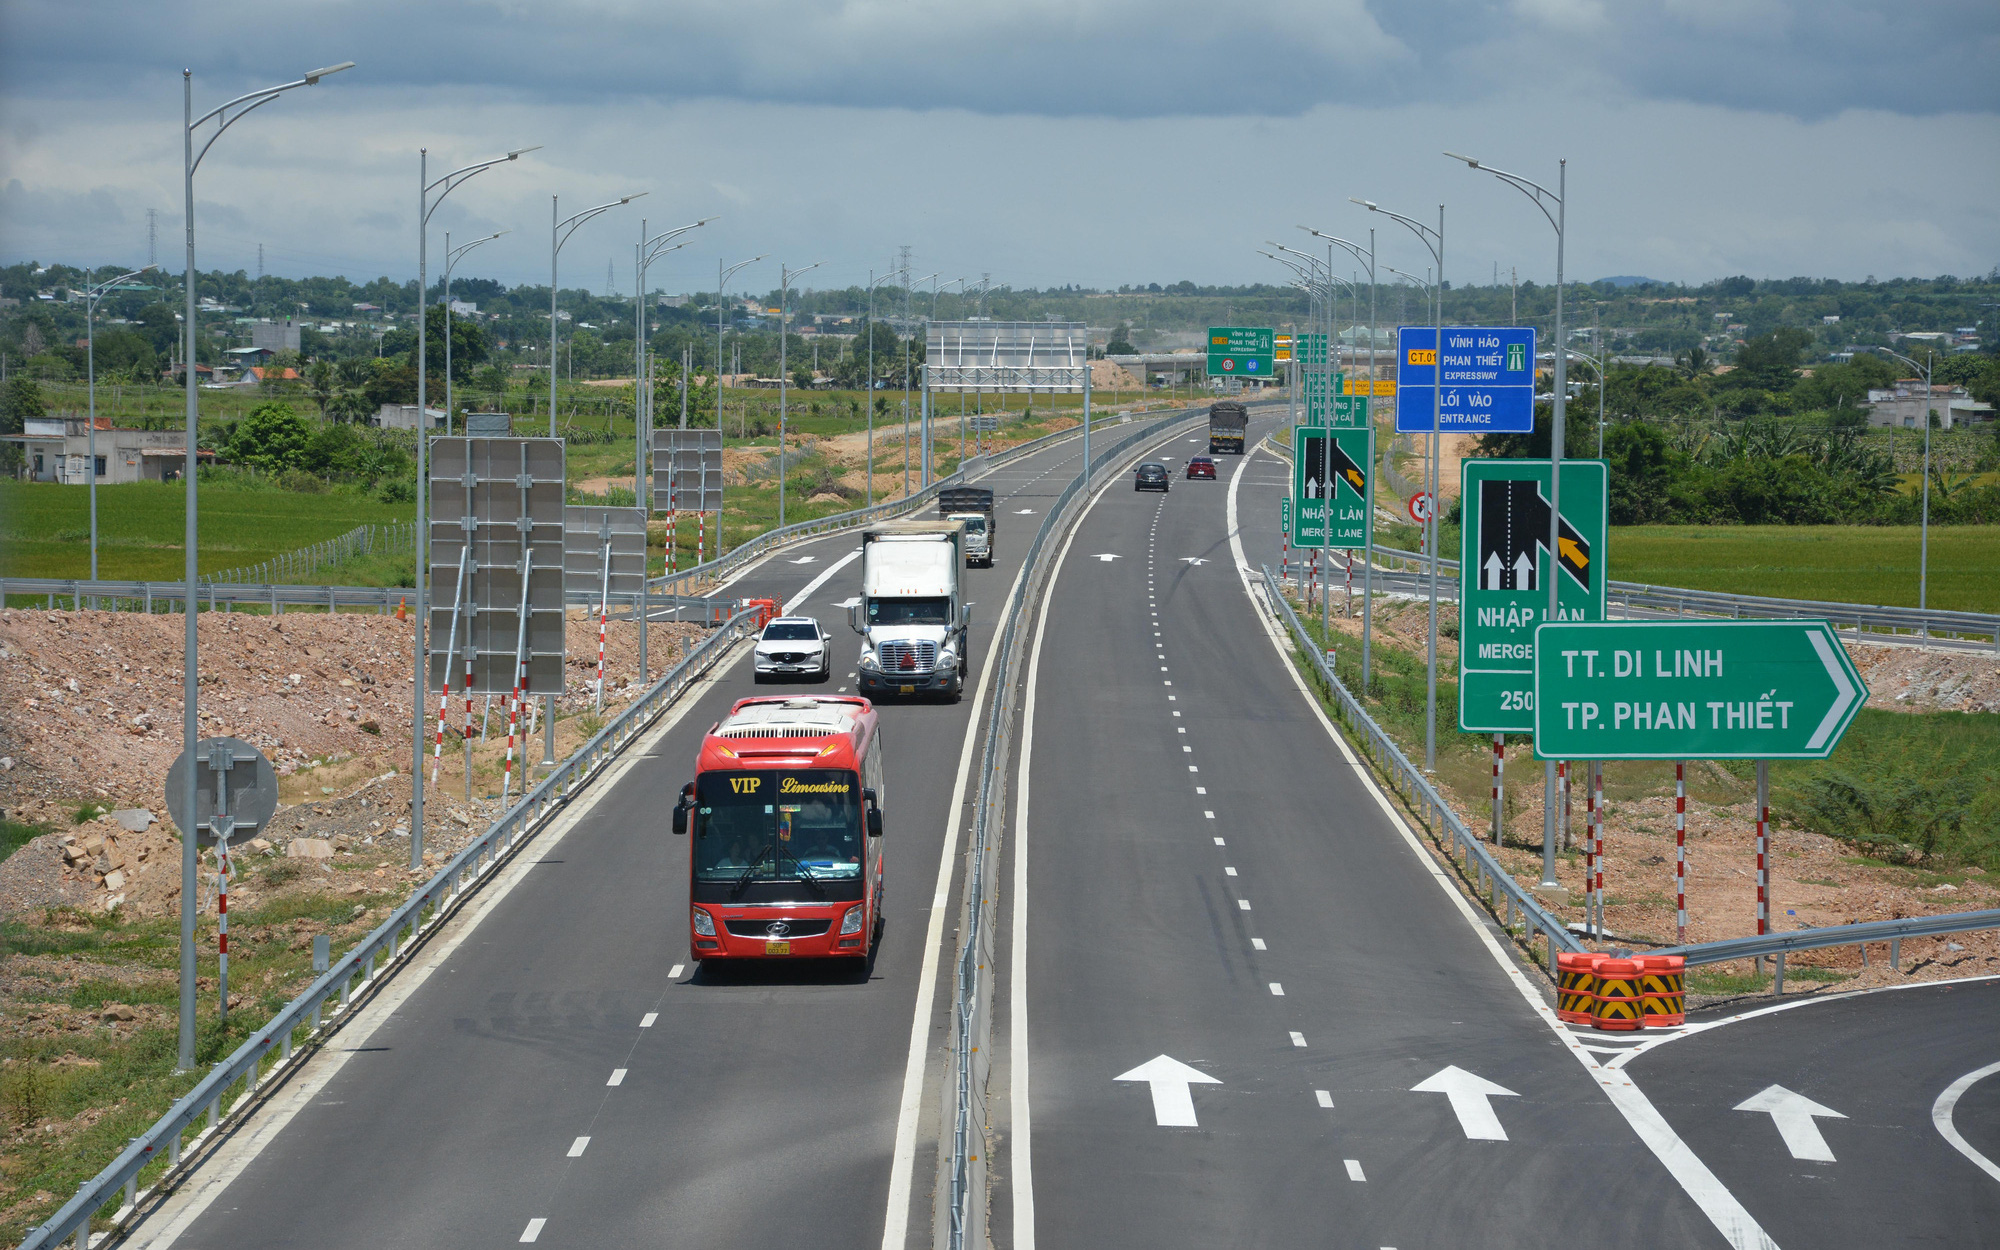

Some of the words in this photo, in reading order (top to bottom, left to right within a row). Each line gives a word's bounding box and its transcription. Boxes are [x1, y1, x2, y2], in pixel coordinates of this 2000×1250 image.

[1245, 338, 1259, 346] THIẾT
[1449, 334, 1473, 348] VĨNH
[1478, 333, 1500, 348] HẢO
[1248, 361, 1257, 370] 60
[1410, 352, 1436, 363] CT.01
[1443, 355, 1471, 366] PHAN
[1476, 350, 1503, 366] THIẾT
[1444, 371, 1498, 380] EXPRESSWAY
[1440, 389, 1460, 407] LỐI
[1468, 391, 1492, 407] VÀO
[1440, 413, 1491, 424] ENTRANCE
[1302, 504, 1334, 522] NHẬP
[1340, 505, 1363, 520] LÀN
[1301, 527, 1333, 537] MERGE
[1338, 529, 1363, 538] LANE
[1477, 601, 1534, 633] NHẬP
[1478, 643, 1533, 660] MERGE
[1561, 650, 1605, 678] TT.
[1614, 650, 1642, 678] DI
[1656, 650, 1723, 678] LINH
[1500, 690, 1533, 711] 250
[1561, 702, 1605, 730] TP.
[1614, 702, 1696, 730] PHAN
[1706, 689, 1794, 730] THIẾT
[730, 777, 761, 794] VIP
[780, 777, 850, 794] Limousine
